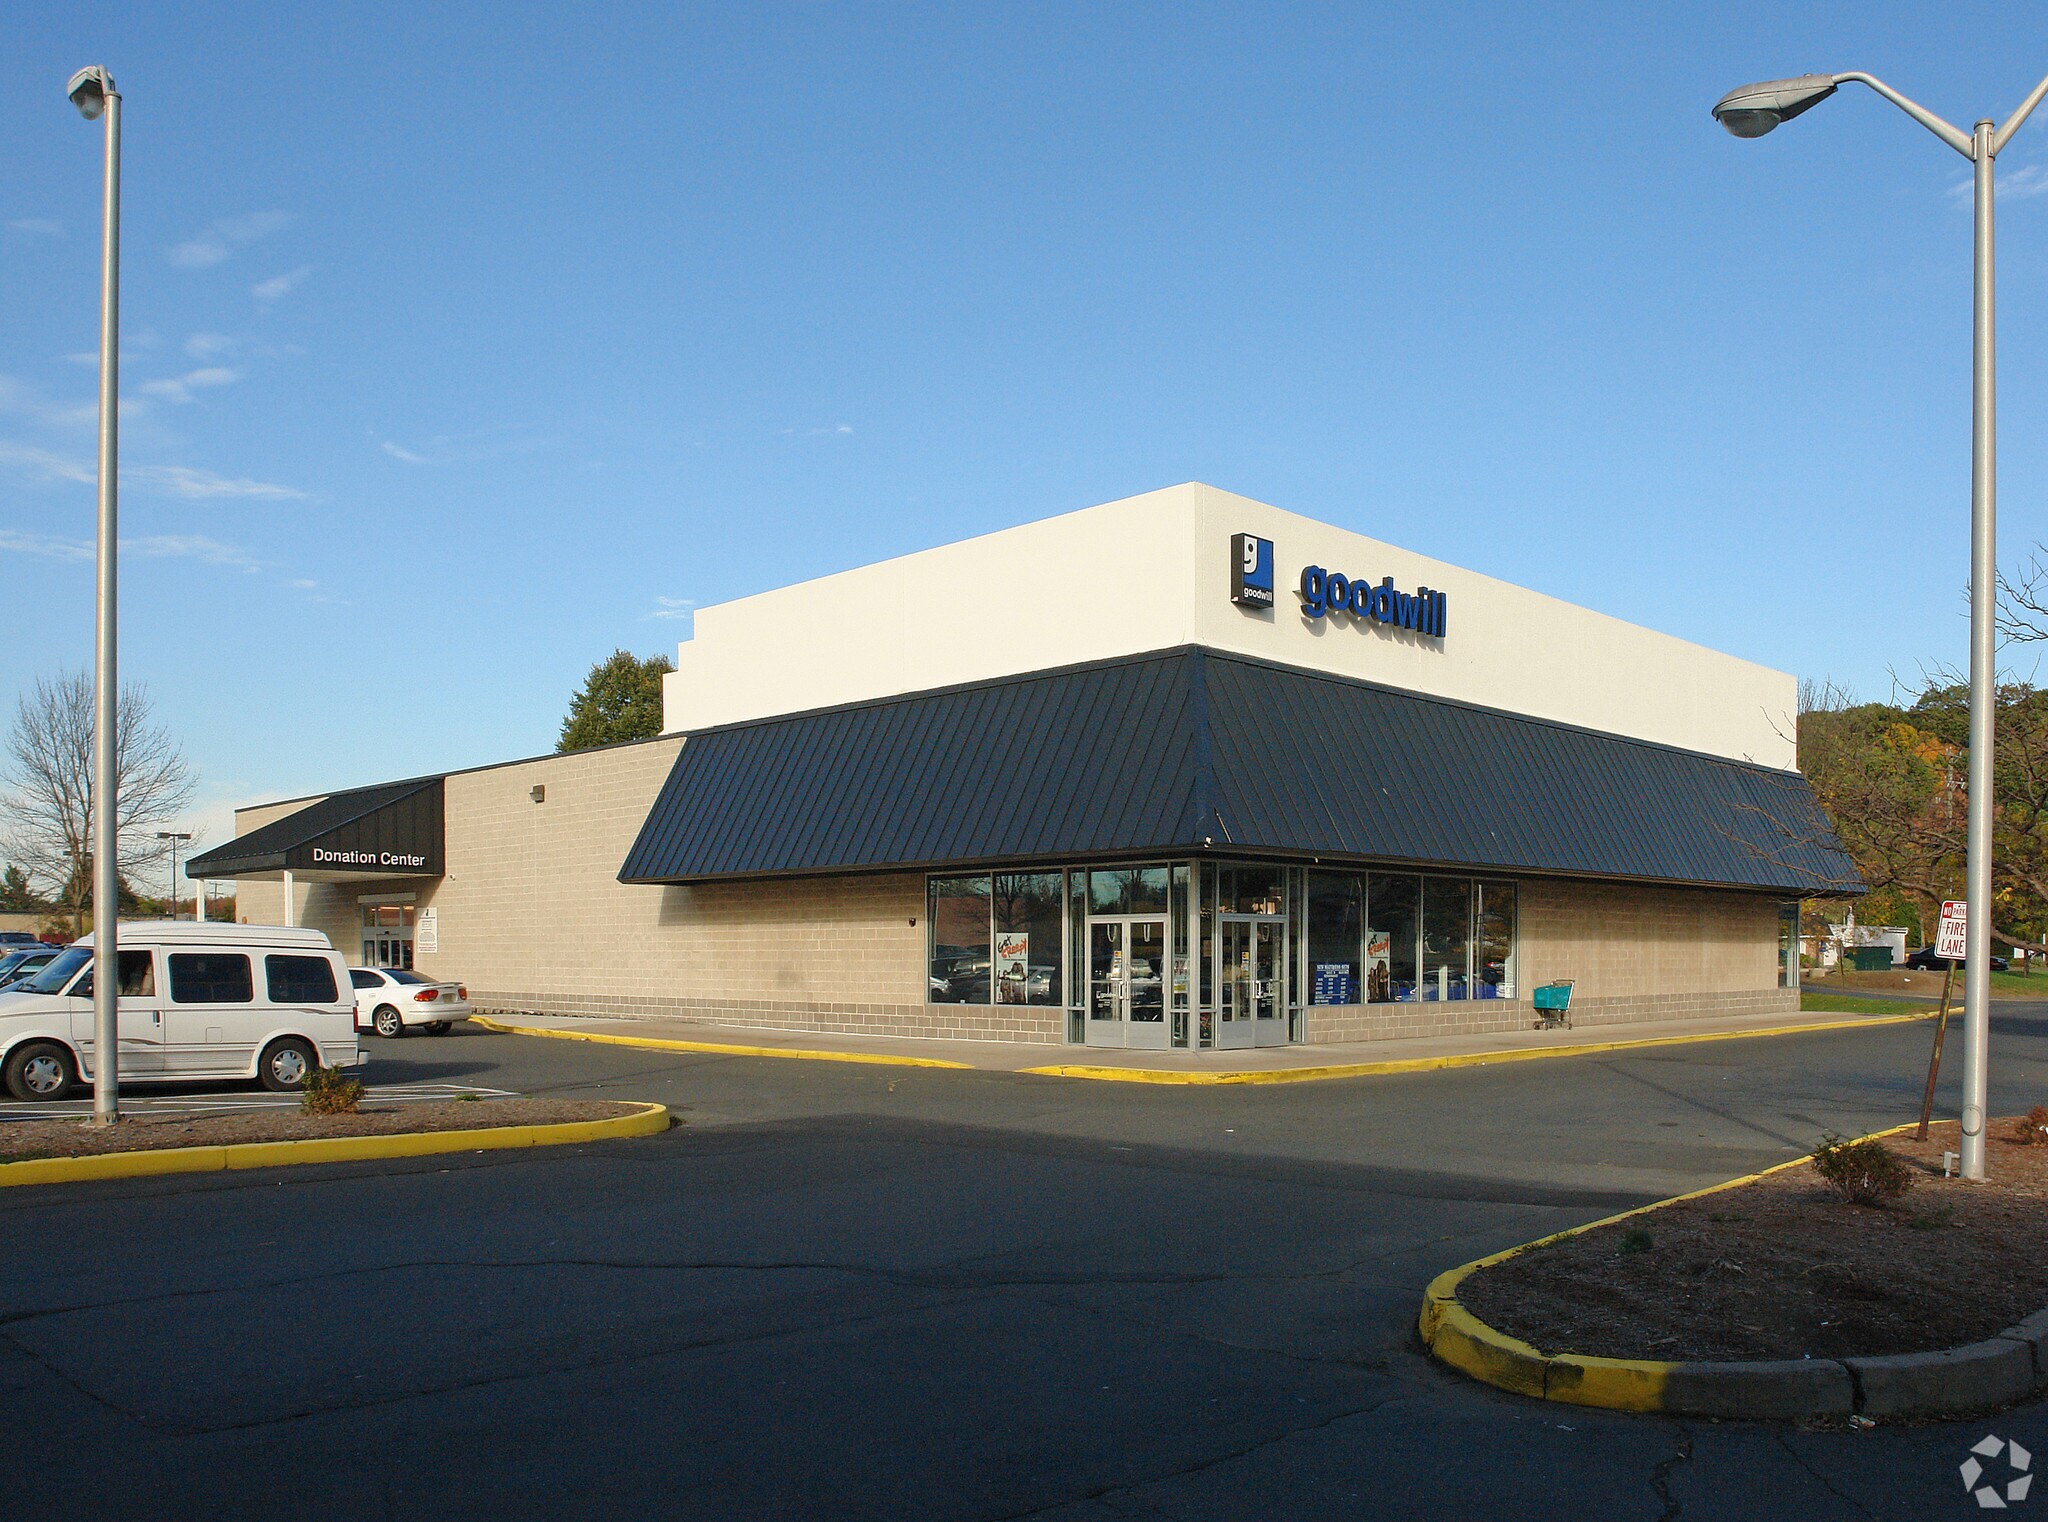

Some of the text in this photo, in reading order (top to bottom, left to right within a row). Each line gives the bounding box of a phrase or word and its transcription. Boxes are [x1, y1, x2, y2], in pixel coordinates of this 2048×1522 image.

[1243, 587, 1273, 602] goodwill
[1301, 565, 1447, 638] goodwill
[313, 848, 425, 866] Donation Center
[1943, 906, 1952, 916] NO
[1945, 921, 1966, 936] FIRE
[1941, 938, 1965, 953] LANE
